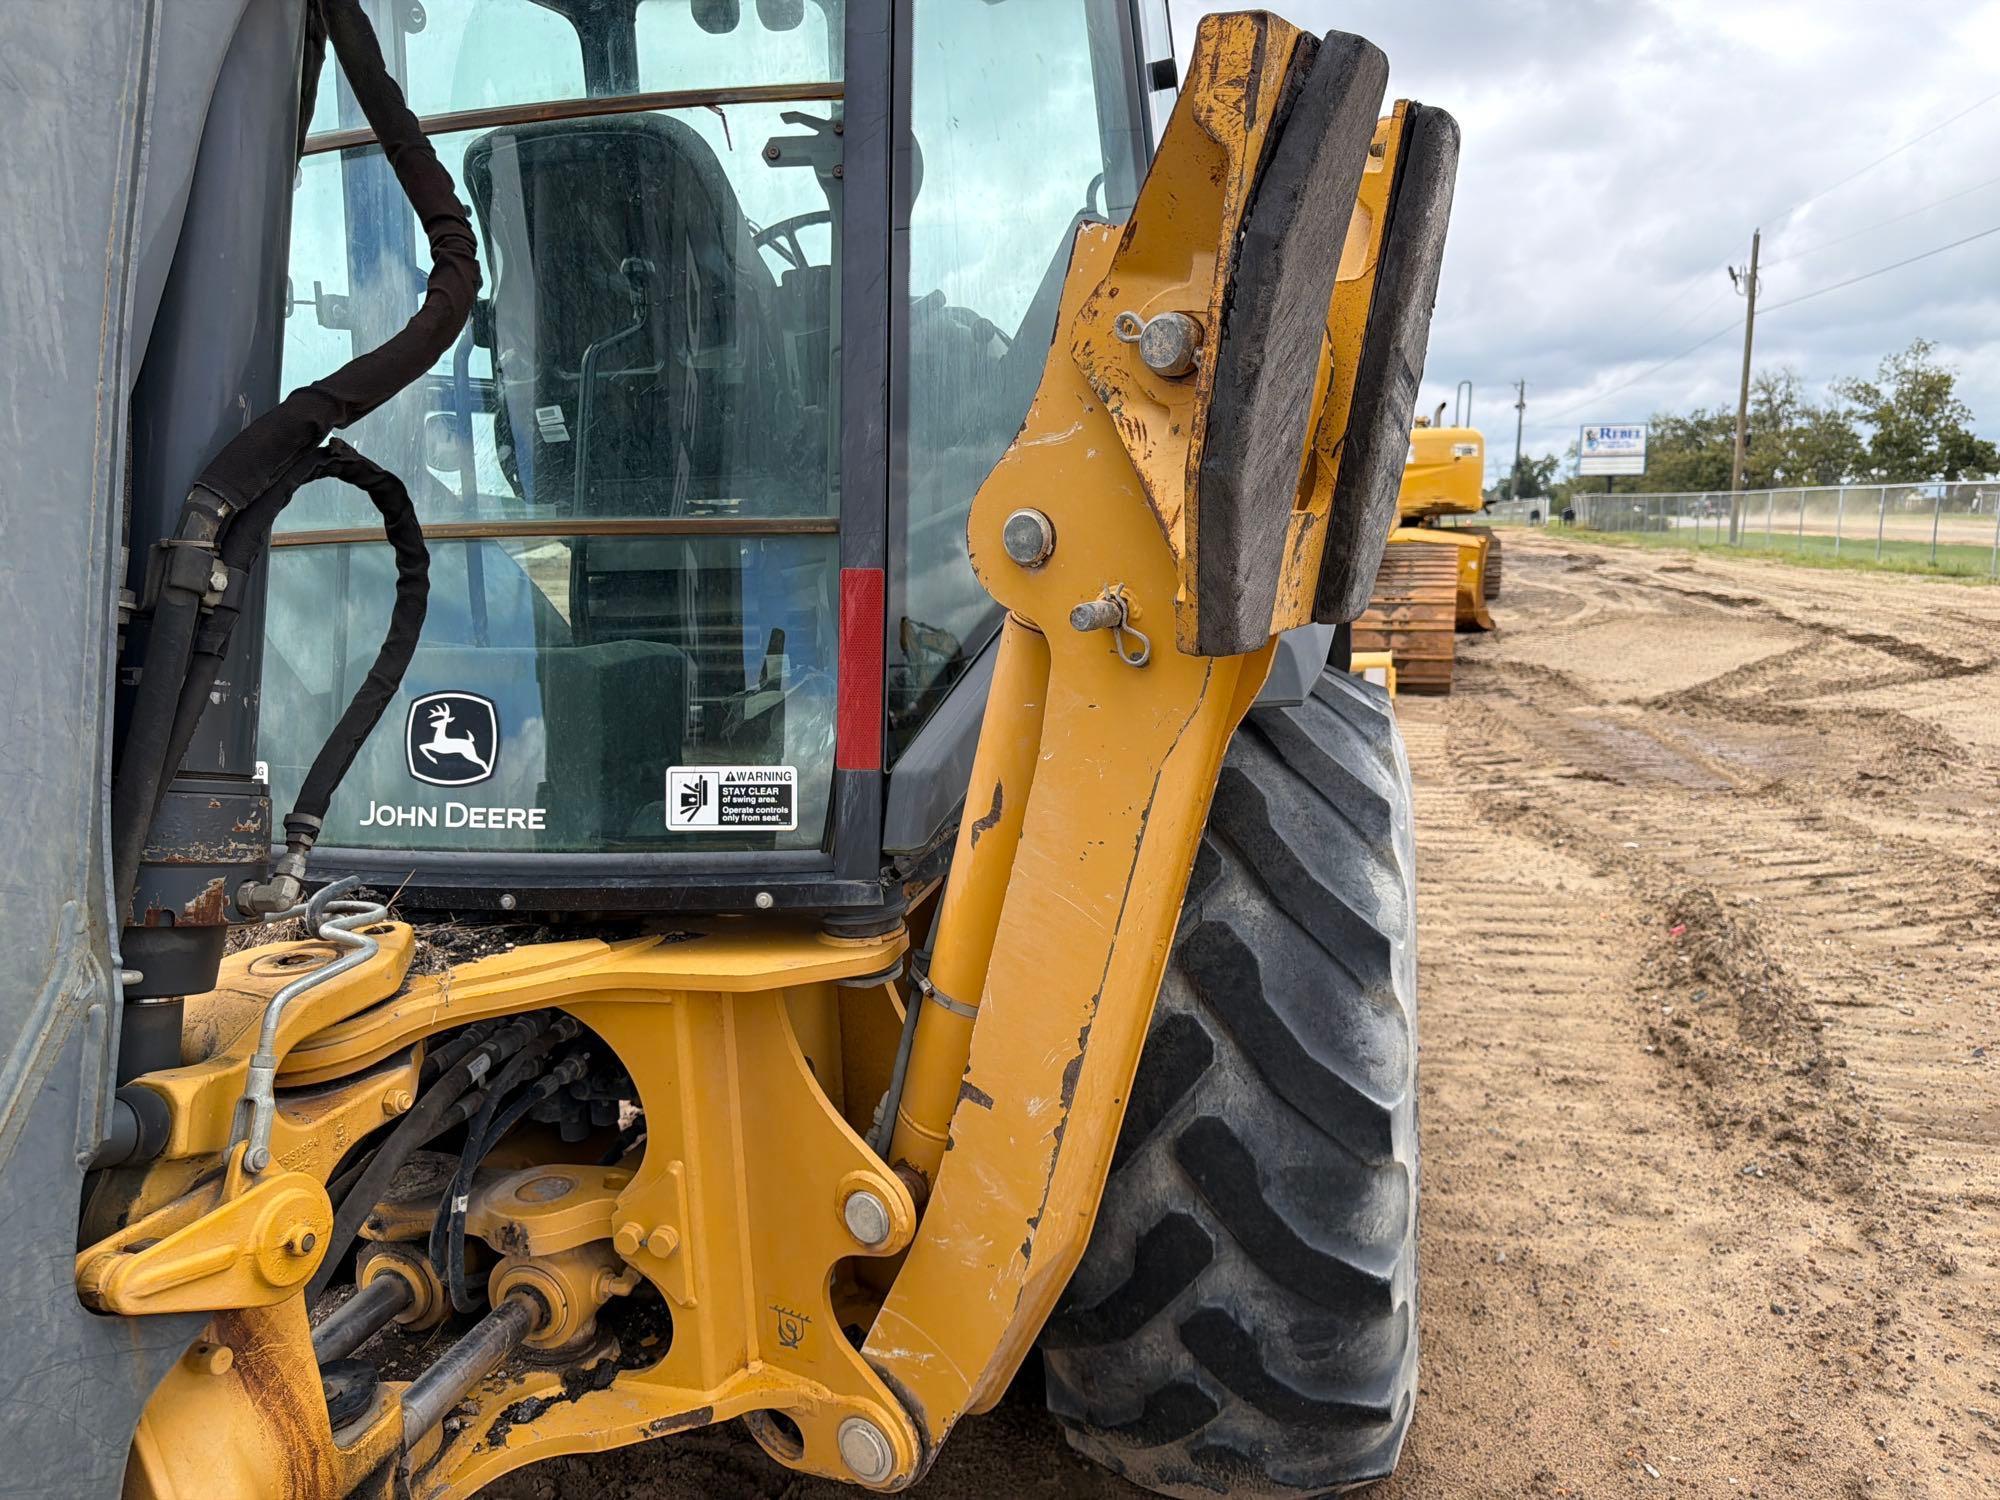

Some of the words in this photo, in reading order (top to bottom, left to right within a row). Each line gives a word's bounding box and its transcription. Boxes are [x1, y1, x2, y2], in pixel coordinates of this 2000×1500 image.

[736, 771, 792, 781] WARNING
[722, 787, 746, 795] STAY
[748, 787, 779, 795] CLEAR
[722, 795, 731, 803] of
[732, 795, 756, 804] swing
[722, 806, 754, 815] Operate
[755, 806, 789, 814] controls
[359, 801, 437, 827] JOHN
[445, 802, 546, 830] DEERE
[722, 814, 740, 823] only
